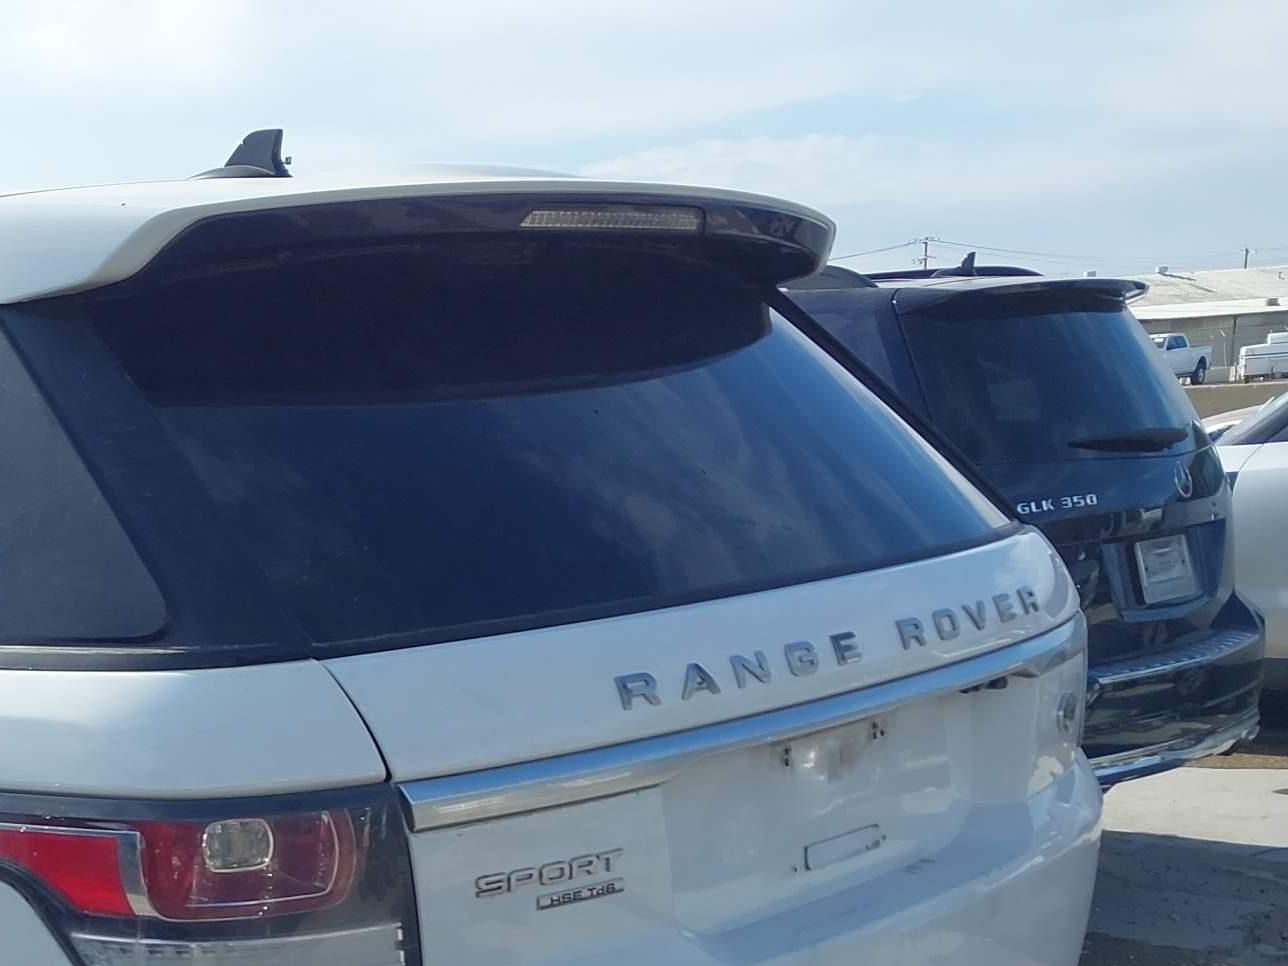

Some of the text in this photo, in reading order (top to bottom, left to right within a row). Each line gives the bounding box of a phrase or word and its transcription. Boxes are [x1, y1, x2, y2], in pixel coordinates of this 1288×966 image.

[1016, 493, 1098, 515] GLK 350
[614, 584, 1041, 711] RANGE ROVER
[474, 847, 624, 898] SPORT
[550, 891, 583, 906] HSE
